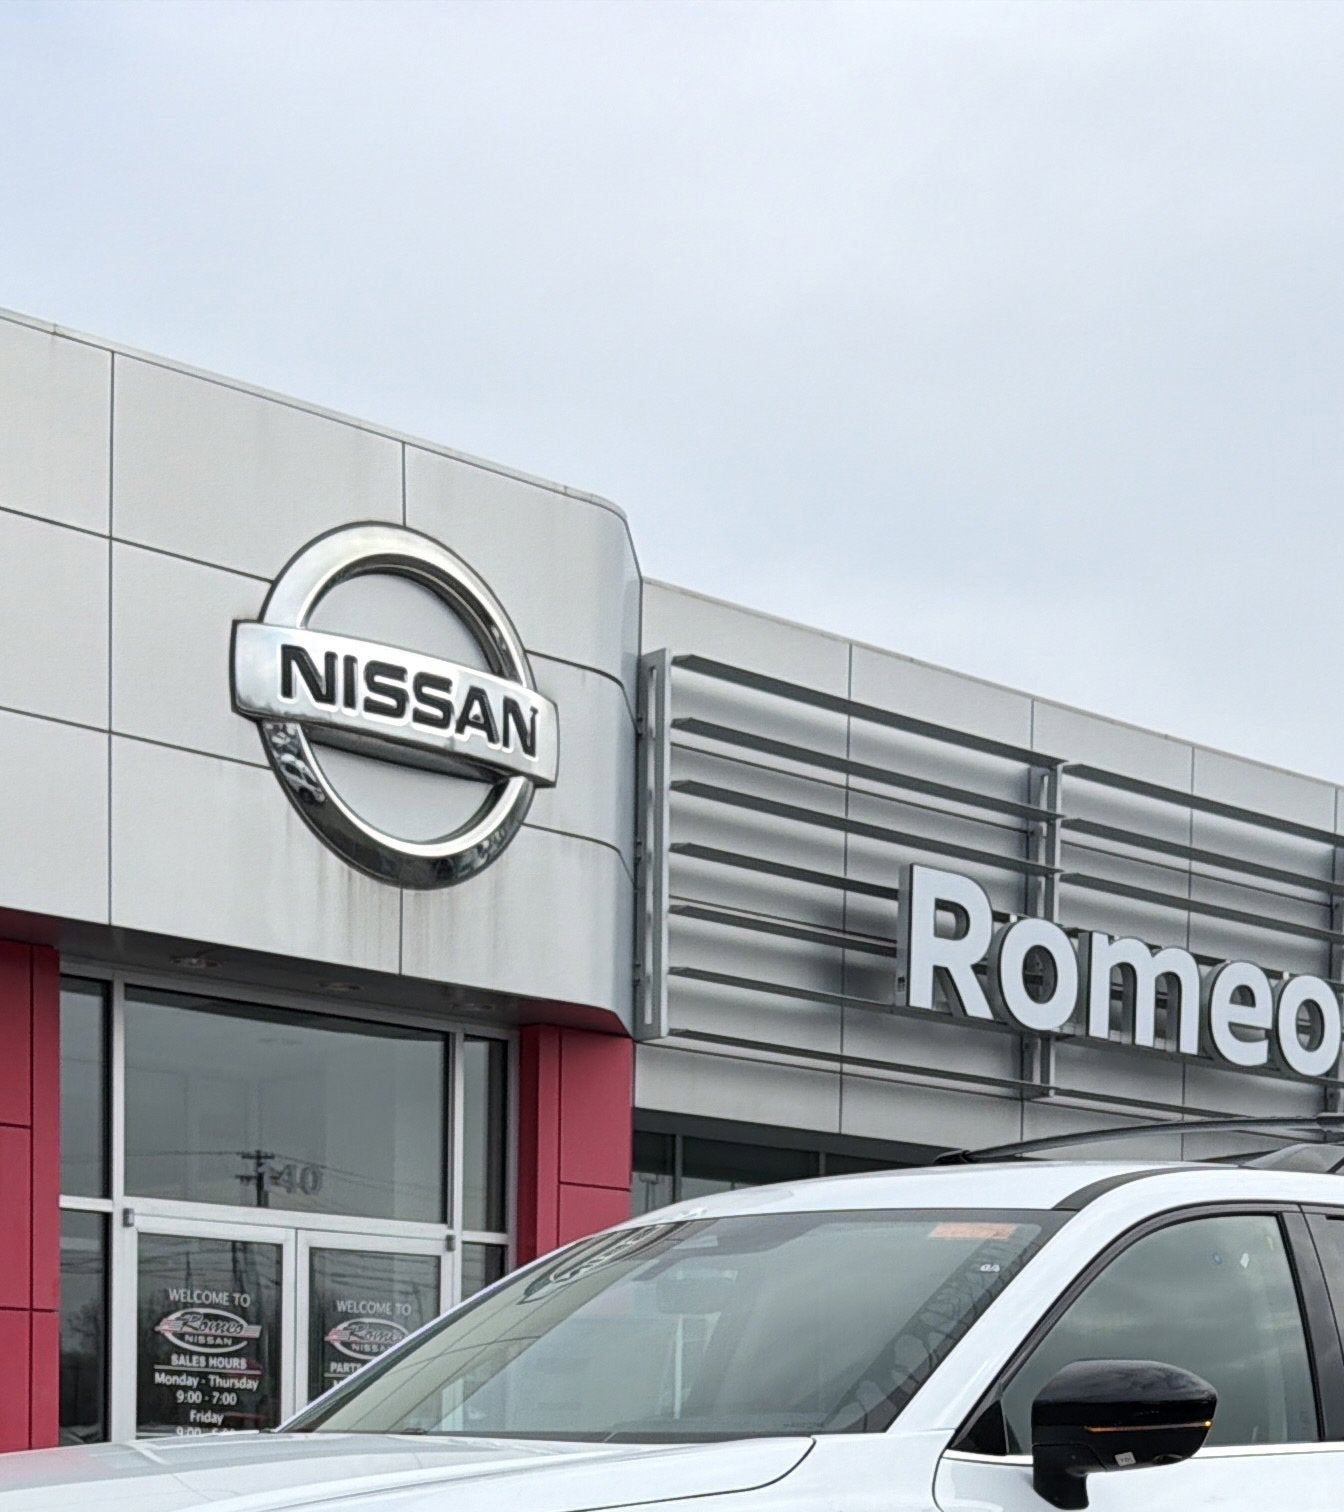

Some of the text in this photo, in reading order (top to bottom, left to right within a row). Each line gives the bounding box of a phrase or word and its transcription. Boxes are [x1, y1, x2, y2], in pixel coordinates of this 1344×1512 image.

[279, 643, 539, 760] NISSAN
[903, 862, 1343, 1077] Romeo
[168, 1288, 251, 1307] WELCOME TO
[336, 1300, 411, 1316] WELCOME TO
[178, 1312, 245, 1334] Romeo
[184, 1335, 233, 1345] NISSAN
[171, 1354, 247, 1369] SALES HOURS
[155, 1372, 199, 1388] Monday
[208, 1375, 259, 1392] Thursday
[176, 1390, 202, 1404] 9:00
[212, 1392, 237, 1405] 7:00
[190, 1410, 224, 1425] Friday
